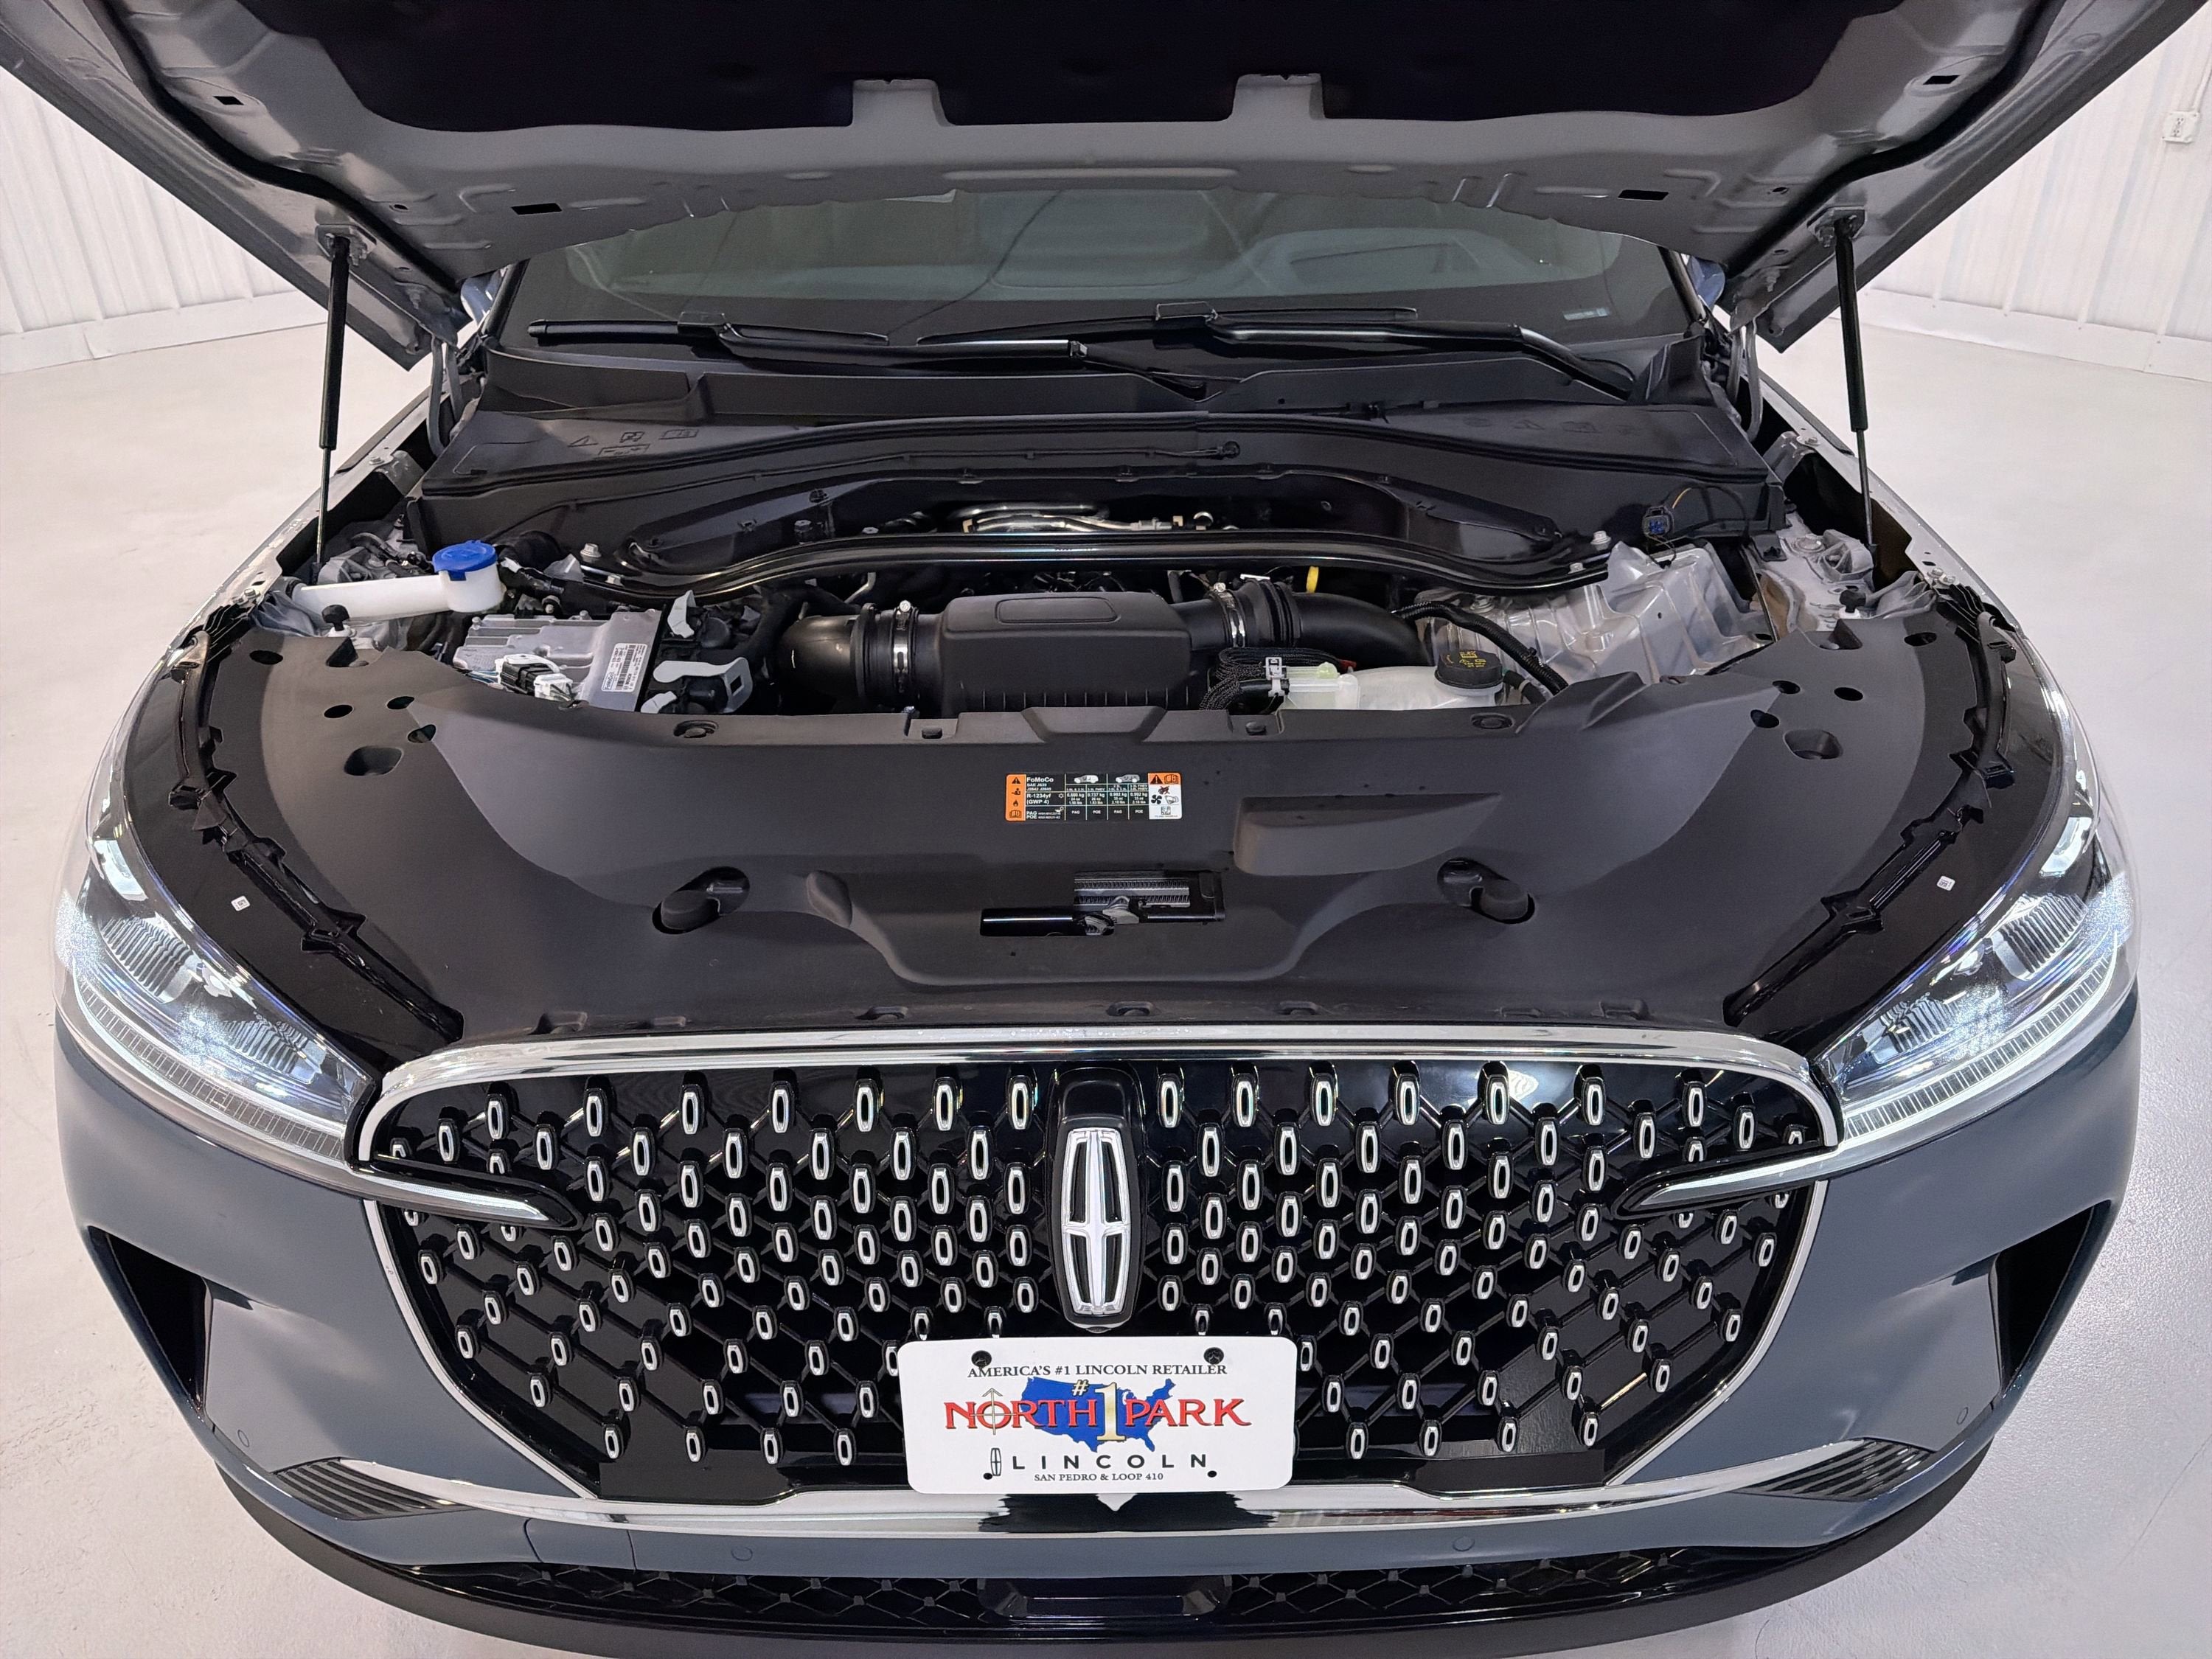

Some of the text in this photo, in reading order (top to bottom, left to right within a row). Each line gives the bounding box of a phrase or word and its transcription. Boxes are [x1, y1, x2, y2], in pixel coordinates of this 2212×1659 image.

[967, 1364, 1228, 1377] AMERICA'S #1 LINCOLN RETAILER
[945, 1399, 1099, 1430] NORTH
[1124, 1398, 1252, 1427] PARK
[1012, 1454, 1206, 1470] LINCOLN
